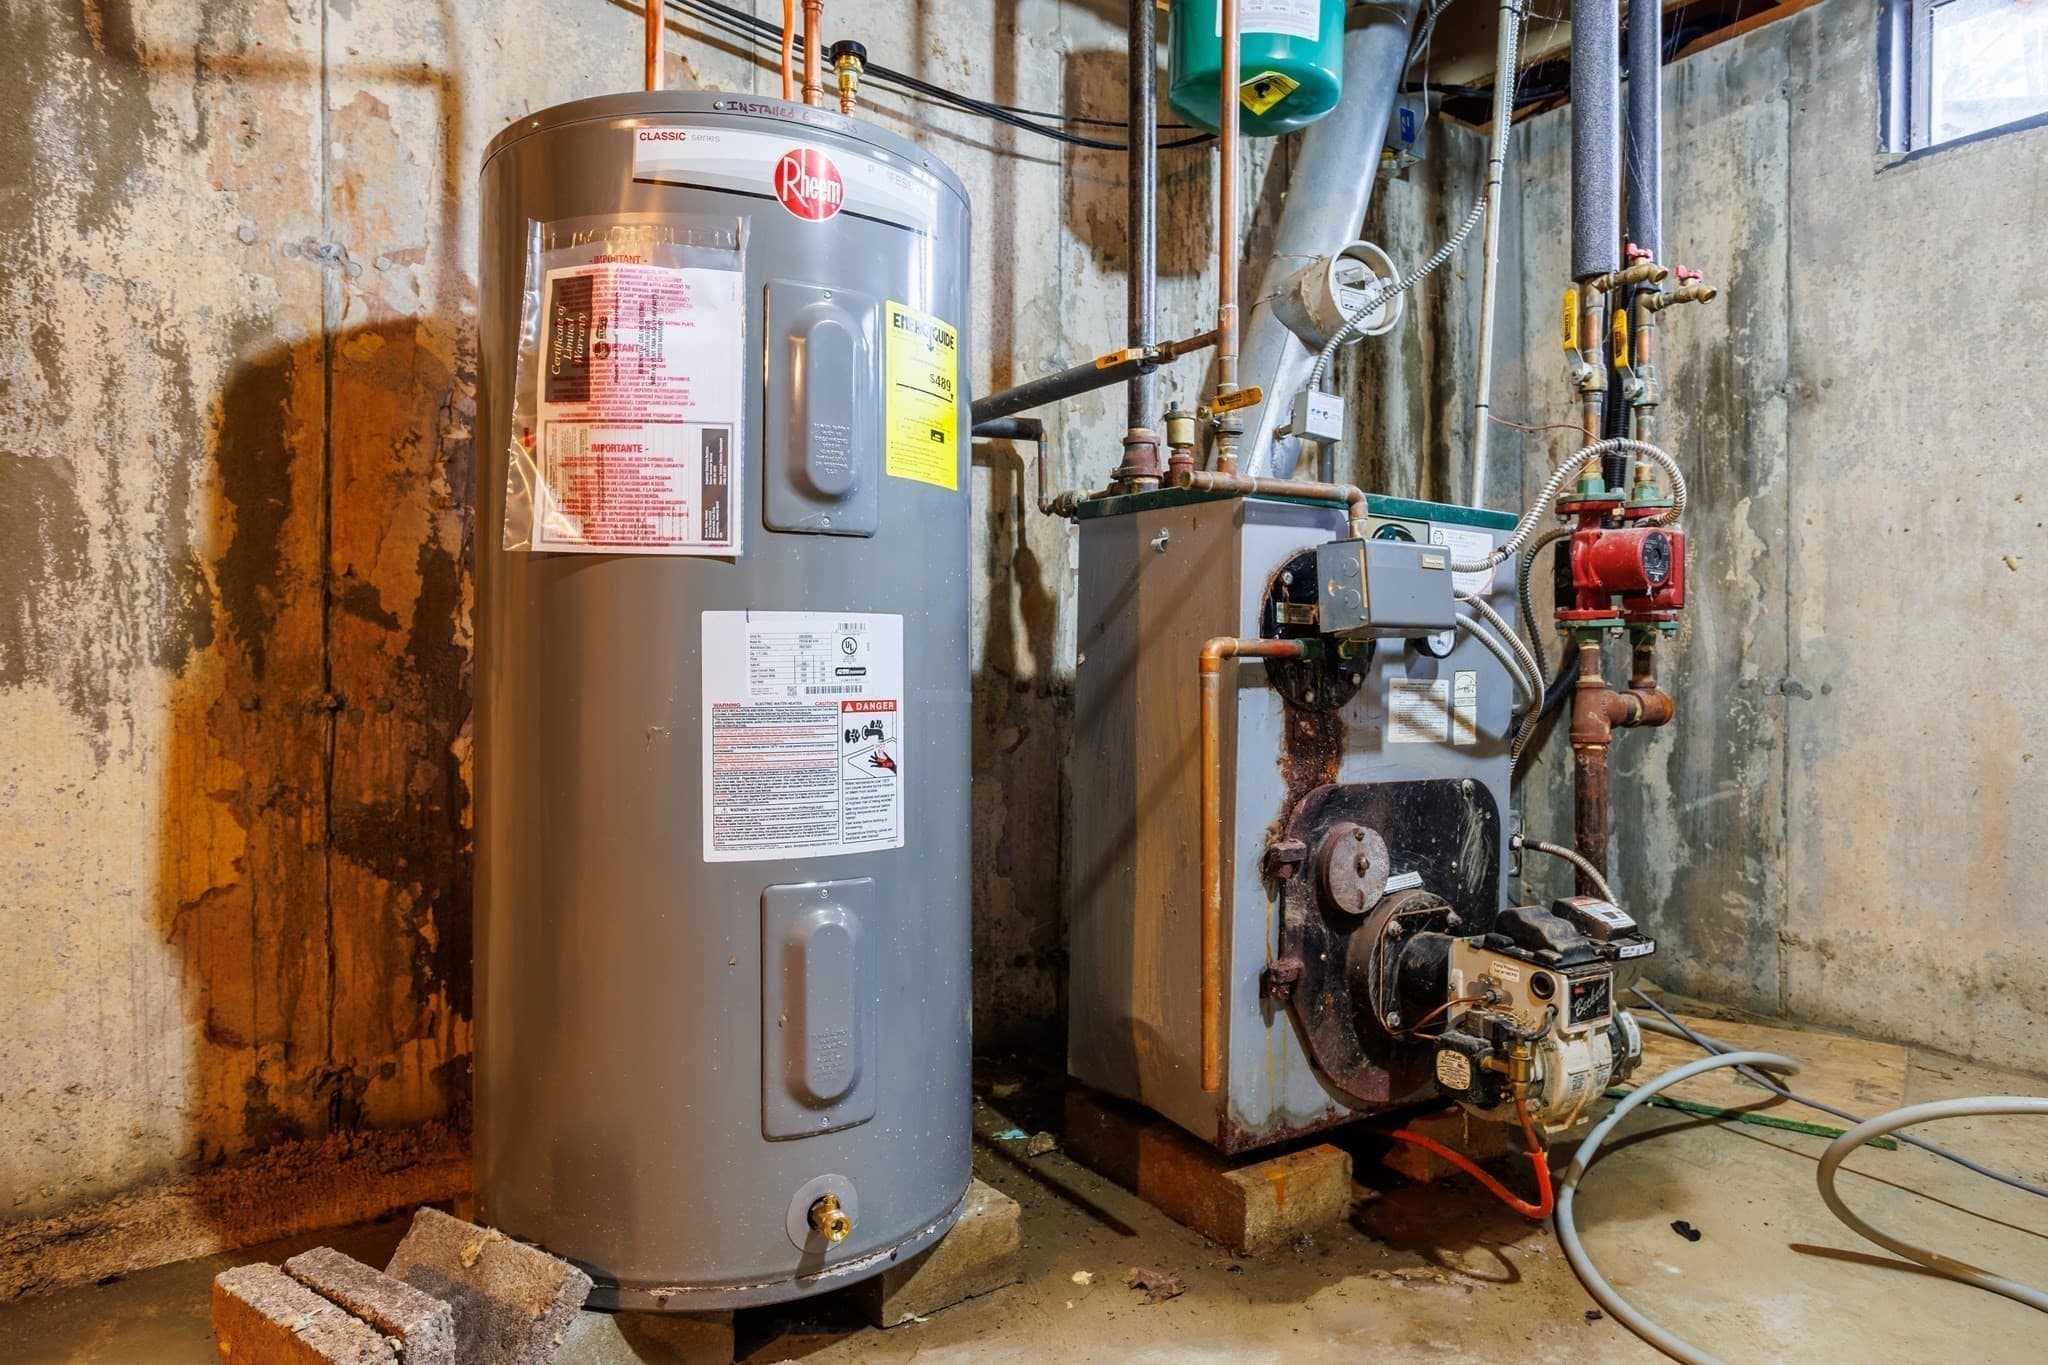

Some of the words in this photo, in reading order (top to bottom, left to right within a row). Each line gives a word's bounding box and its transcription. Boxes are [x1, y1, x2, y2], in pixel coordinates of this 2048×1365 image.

[639, 131, 687, 141] CLASSIC
[691, 133, 721, 143] series
[782, 149, 842, 208] Rheem
[593, 255, 642, 264] IMPORTANT
[556, 302, 567, 315] of
[552, 318, 564, 375] Certificate
[563, 317, 575, 360] Limited
[573, 312, 587, 363] Warranty
[591, 443, 643, 453] IMPORTANTE
[855, 701, 894, 711] DANGER
[1575, 979, 1608, 1017] Beckett
